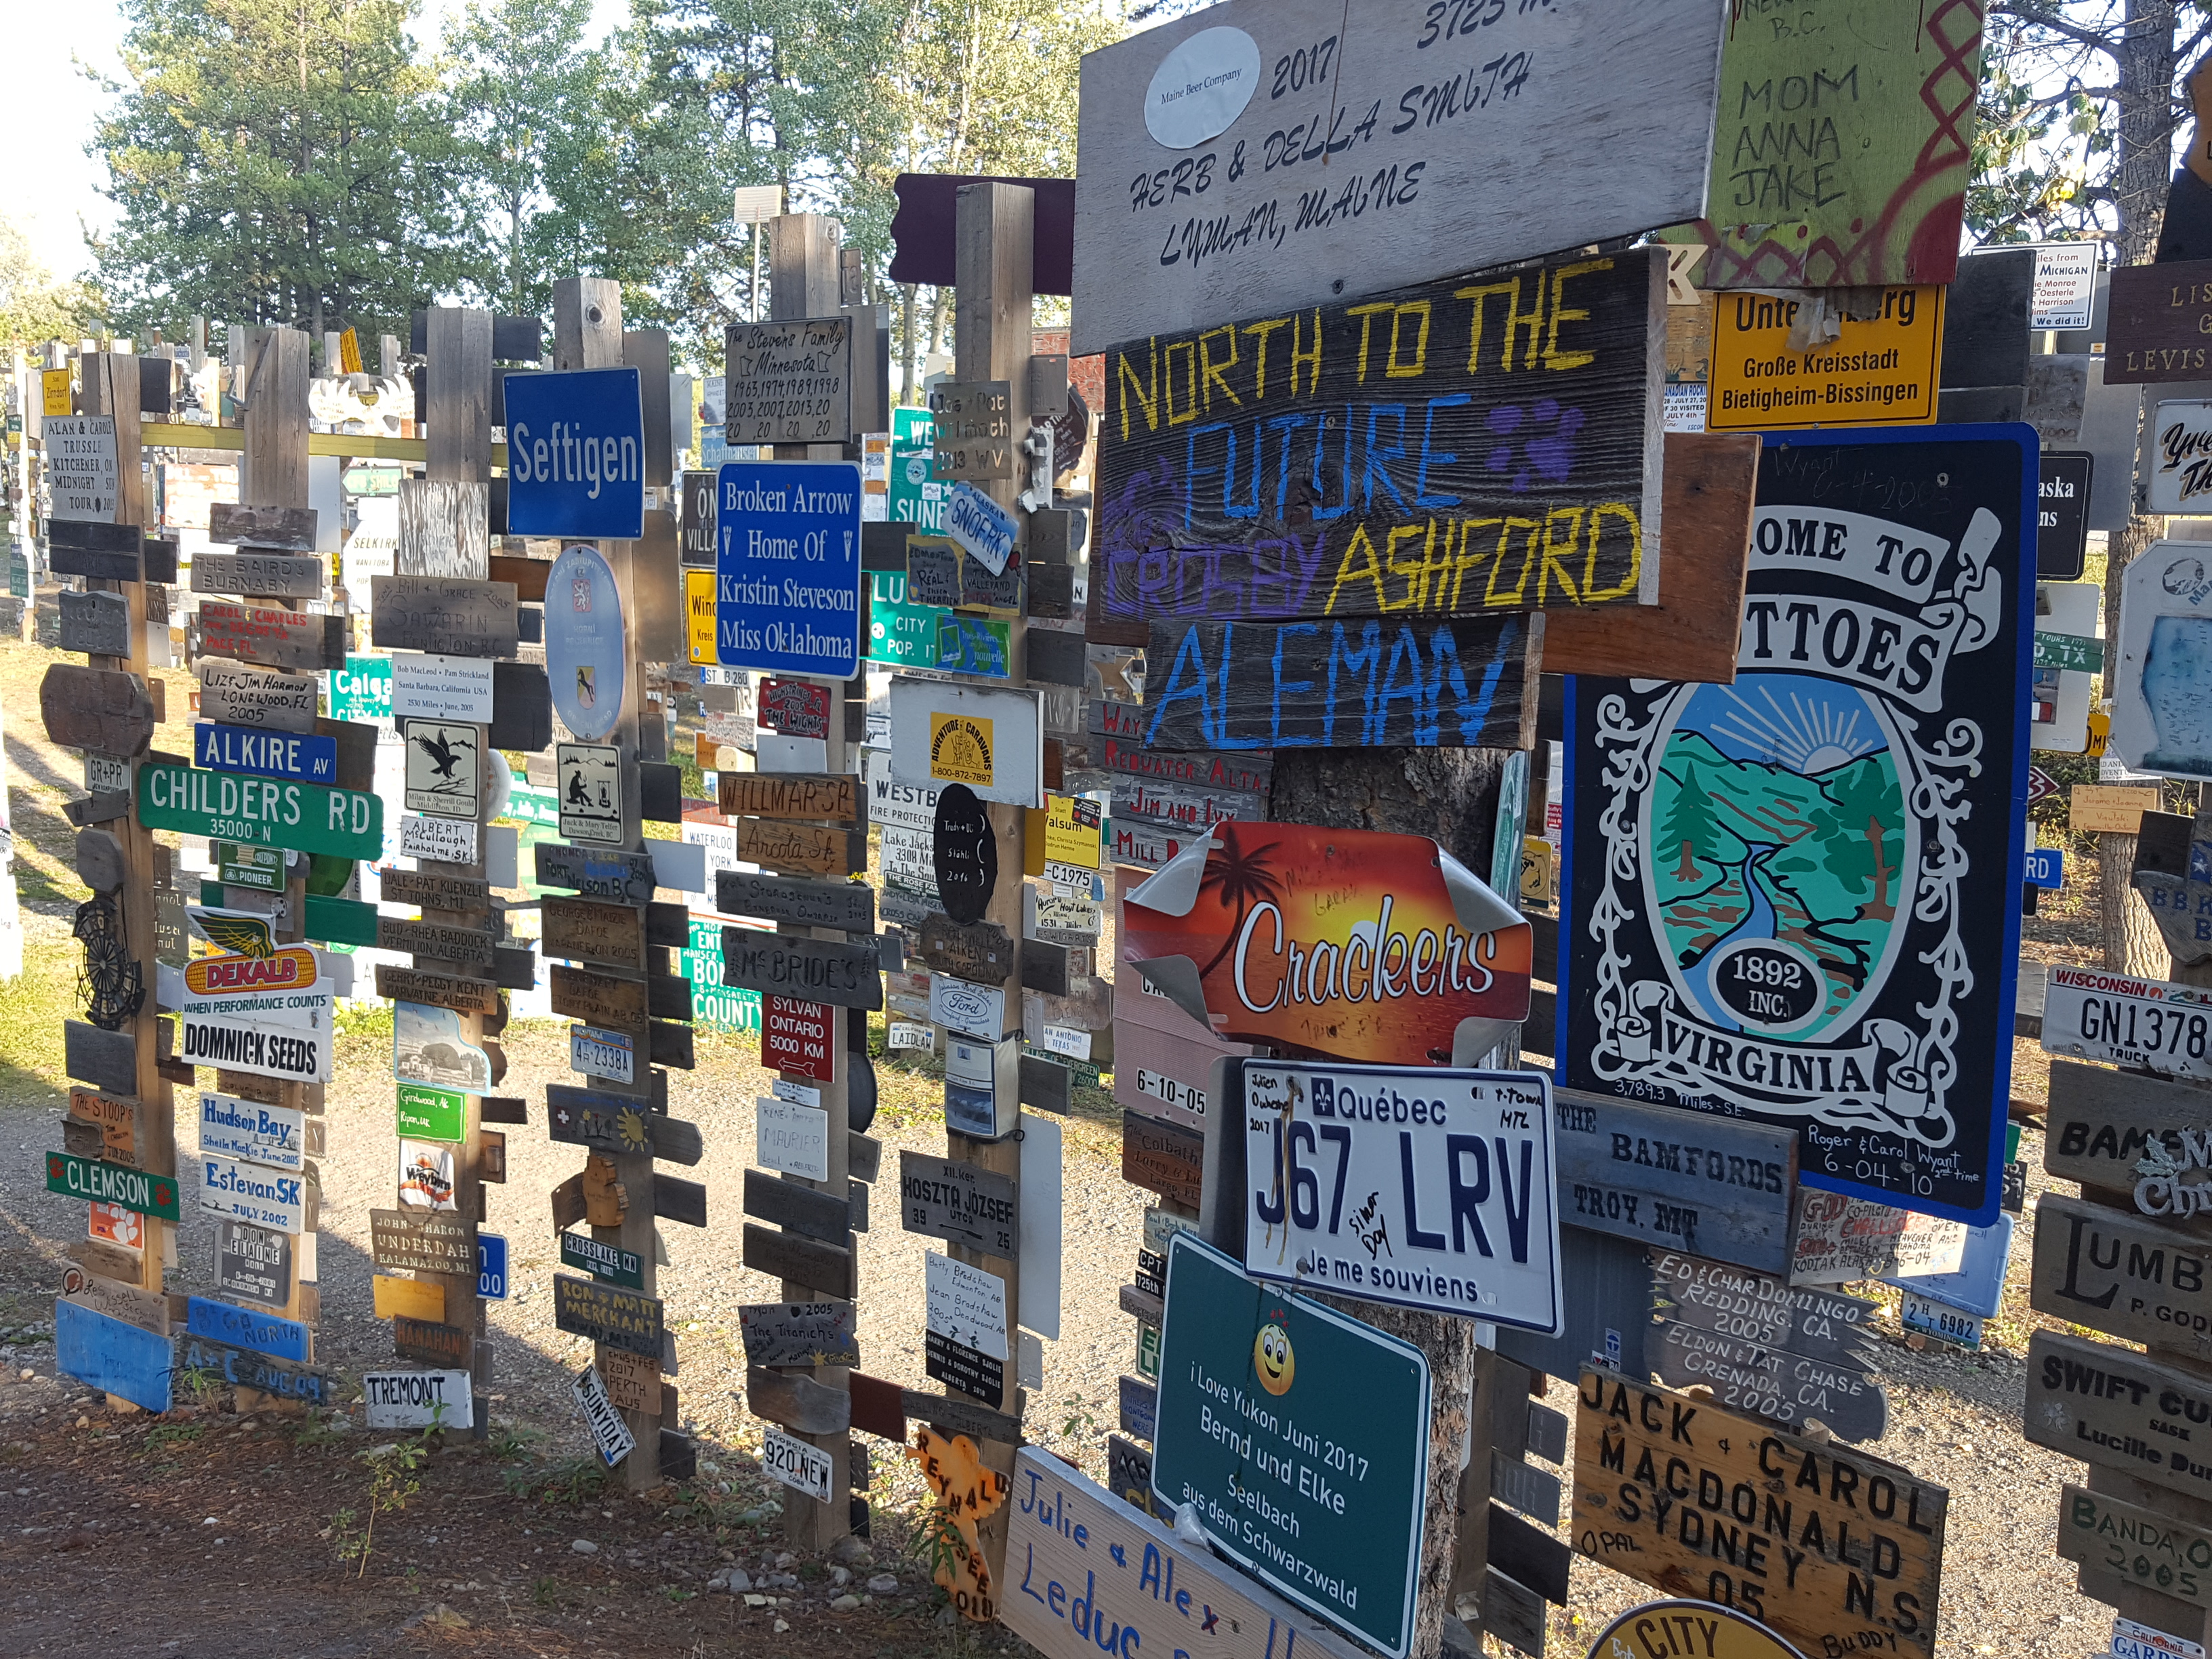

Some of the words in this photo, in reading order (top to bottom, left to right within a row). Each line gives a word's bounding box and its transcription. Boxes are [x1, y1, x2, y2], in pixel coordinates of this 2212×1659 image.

[1271, 35, 1337, 100] 2017
[1161, 87, 1185, 105] Maine
[1185, 81, 1203, 98] Beer
[1204, 67, 1242, 92] Company
[1740, 64, 1858, 119] MOM
[1130, 153, 1216, 213] HERB
[1227, 140, 1246, 182] &
[1263, 99, 1382, 171] DELLA
[1734, 117, 1841, 169] ANNA
[1729, 162, 1847, 211] JAKE
[1160, 199, 1287, 269] LYMAN,
[1294, 161, 1426, 232] MAINE
[2039, 265, 2087, 276] MICHIGAN
[2045, 279, 2076, 288] Monroe
[2039, 298, 2074, 306] Harrison
[2041, 288, 2074, 297] Oesterle
[747, 327, 796, 351] Stevens
[801, 322, 844, 354] Family
[2037, 317, 2052, 325] We
[2055, 316, 2070, 325] did
[2073, 316, 2085, 325] it!
[755, 352, 815, 376] Minnesota
[1118, 307, 1324, 441] NORTH
[1347, 300, 1430, 386] TO
[1453, 258, 1614, 375] THE
[1743, 356, 1796, 379] Große
[1804, 348, 1899, 375] Kreisstadt
[47, 386, 67, 401] Zirndorf
[1722, 382, 1918, 412] Bietigheim-Bissingen
[514, 422, 636, 499] Seftigen
[1185, 393, 1471, 532] FUTURE
[725, 480, 787, 512] Broken
[792, 483, 853, 515] Arrow
[354, 537, 398, 550] SELKIRK
[747, 529, 798, 561] Home
[804, 531, 827, 562] Of
[1323, 501, 1643, 617] ASHFORD
[1875, 535, 1932, 586] TO
[193, 557, 225, 573] THE
[203, 575, 290, 592] BURNABY
[720, 574, 778, 606] Kristin
[783, 578, 855, 612] Steveson
[721, 619, 761, 650] Miss
[765, 622, 853, 660] Oklahoma
[397, 665, 409, 674] Bob
[410, 666, 437, 676] MacLeod
[444, 669, 457, 678] Pam
[458, 669, 489, 680] Strickland
[398, 680, 414, 689] Santa
[415, 682, 439, 693] Barbara,
[441, 683, 471, 694] California
[473, 687, 487, 697] USA
[1145, 617, 1519, 750] ALEMAN
[205, 731, 302, 772] ALKIRE
[314, 758, 329, 775] AV
[932, 719, 959, 762] ADVENTURE
[966, 722, 991, 770] CARAVANS
[1105, 742, 1194, 780] REDWATER
[932, 767, 991, 783] 1-800-872-7897
[150, 769, 301, 825] CHILDERS
[329, 792, 371, 835] RD
[1130, 787, 1160, 815] JIM
[1167, 802, 1197, 823] AND
[210, 819, 252, 840] 35000
[263, 826, 271, 842] N
[413, 821, 462, 835] ALBERT
[1118, 830, 1157, 862] MILL
[2026, 857, 2049, 878] RD
[1233, 894, 1496, 1012] Crackers
[207, 958, 297, 988] DEKALB
[1733, 955, 1801, 989] 1892
[2055, 970, 2148, 996] WISCONSIN
[184, 1000, 211, 1015] WHEN
[213, 997, 284, 1013] PERFORMANCE
[287, 994, 327, 1009] COUNTS
[773, 996, 821, 1019] SYLVAN
[949, 994, 979, 1015] Ford
[1748, 991, 1788, 1018] INC.
[770, 1015, 824, 1039] ONTARIO
[892, 1031, 932, 1049] LAIDLAW
[185, 1023, 264, 1066] DOMNICK
[269, 1029, 317, 1075] SEEDS
[770, 1036, 798, 1054] 5000
[804, 1042, 824, 1059] KM
[1664, 1019, 1870, 1093] VIRGINIA
[2108, 1046, 2150, 1064] TRUCK
[1136, 1069, 1206, 1114] 6-10-05
[1338, 1087, 1446, 1124] Québec
[203, 1099, 256, 1131] Hudson
[258, 1109, 291, 1147] Bay
[1557, 1105, 1597, 1133] THE
[1611, 1132, 1782, 1194] BAMFORDS
[67, 1162, 149, 1207] CLEMSON
[1256, 1118, 1351, 1235] J67
[1399, 1132, 1532, 1263] LRV
[232, 1203, 259, 1223] JULY
[262, 1210, 288, 1227] 2002
[1654, 1202, 1698, 1233] MT
[1307, 1249, 1327, 1275] Je
[1334, 1258, 1362, 1283] me
[1371, 1263, 1478, 1303] souviens
[1657, 1254, 1692, 1282] ED
[1708, 1267, 1756, 1297] CHAR
[1758, 1279, 1860, 1323] DOMINGO
[566, 1300, 657, 1338] MERCHANT
[613, 1295, 657, 1319] MATT
[1940, 1305, 1973, 1338] 6982
[1715, 1312, 1775, 1342] 2005
[1922, 1326, 1957, 1343] WYOMING
[367, 1376, 445, 1406] TREMONT
[610, 1376, 647, 1397] PERTH
[1795, 1363, 1864, 1397] CHASE
[2042, 1356, 2150, 1405] SWIFT
[1724, 1385, 1797, 1420] 2005
[1197, 1365, 1229, 1406] Love
[1233, 1387, 1278, 1435] Yukon
[1283, 1420, 1319, 1458] Juni
[1324, 1441, 1368, 1482] 2017
[2150, 1420, 2190, 1441] SASK
[766, 1431, 808, 1453] GEORGIA
[1580, 1374, 1698, 1447] JACK
[1759, 1437, 1933, 1536] CAROL
[2077, 1420, 2162, 1464] Lucille
[766, 1442, 796, 1473] 920
[800, 1454, 828, 1490] NEW
[1200, 1405, 1252, 1460] Bernd
[1256, 1445, 1292, 1486] und
[1298, 1466, 1346, 1516] Elke
[1227, 1473, 1300, 1538] Seelbach
[1600, 1429, 1900, 1581] MACDONALD
[1020, 1469, 1089, 1549] Julie
[1139, 1542, 1218, 1635] Alex
[1182, 1483, 1206, 1512] aus
[1208, 1496, 1238, 1536] dem
[1242, 1520, 1357, 1610] Schwarzwald
[1582, 1530, 1642, 1557] OPAL
[1619, 1483, 1805, 1589] SYDNEY
[1845, 1572, 1928, 1641] N.S.
[2105, 1544, 2198, 1597] 2005
[1635, 1616, 1719, 1659] CITY
